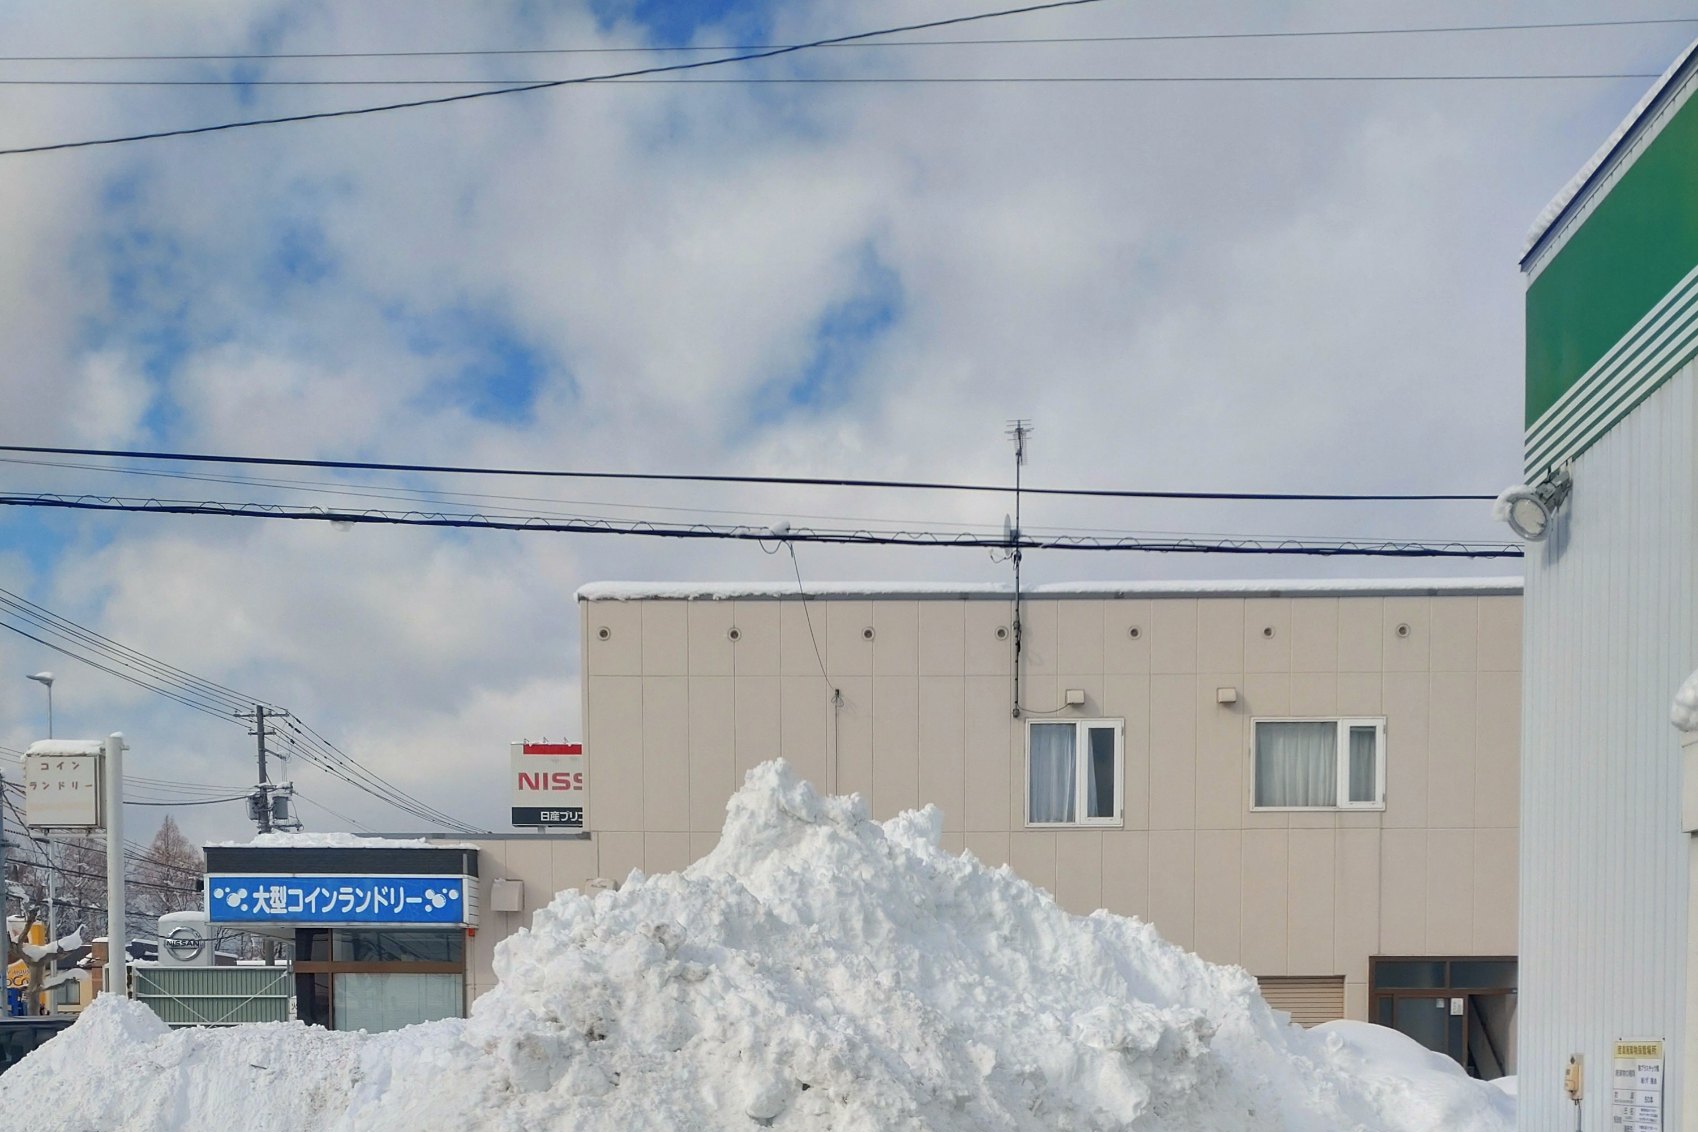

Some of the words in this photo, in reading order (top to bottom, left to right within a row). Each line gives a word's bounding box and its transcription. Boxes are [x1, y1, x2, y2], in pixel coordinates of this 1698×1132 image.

[41, 761, 80, 771] コイン
[29, 781, 93, 791] ランドリー
[252, 885, 422, 914] 大型コインランドリー
